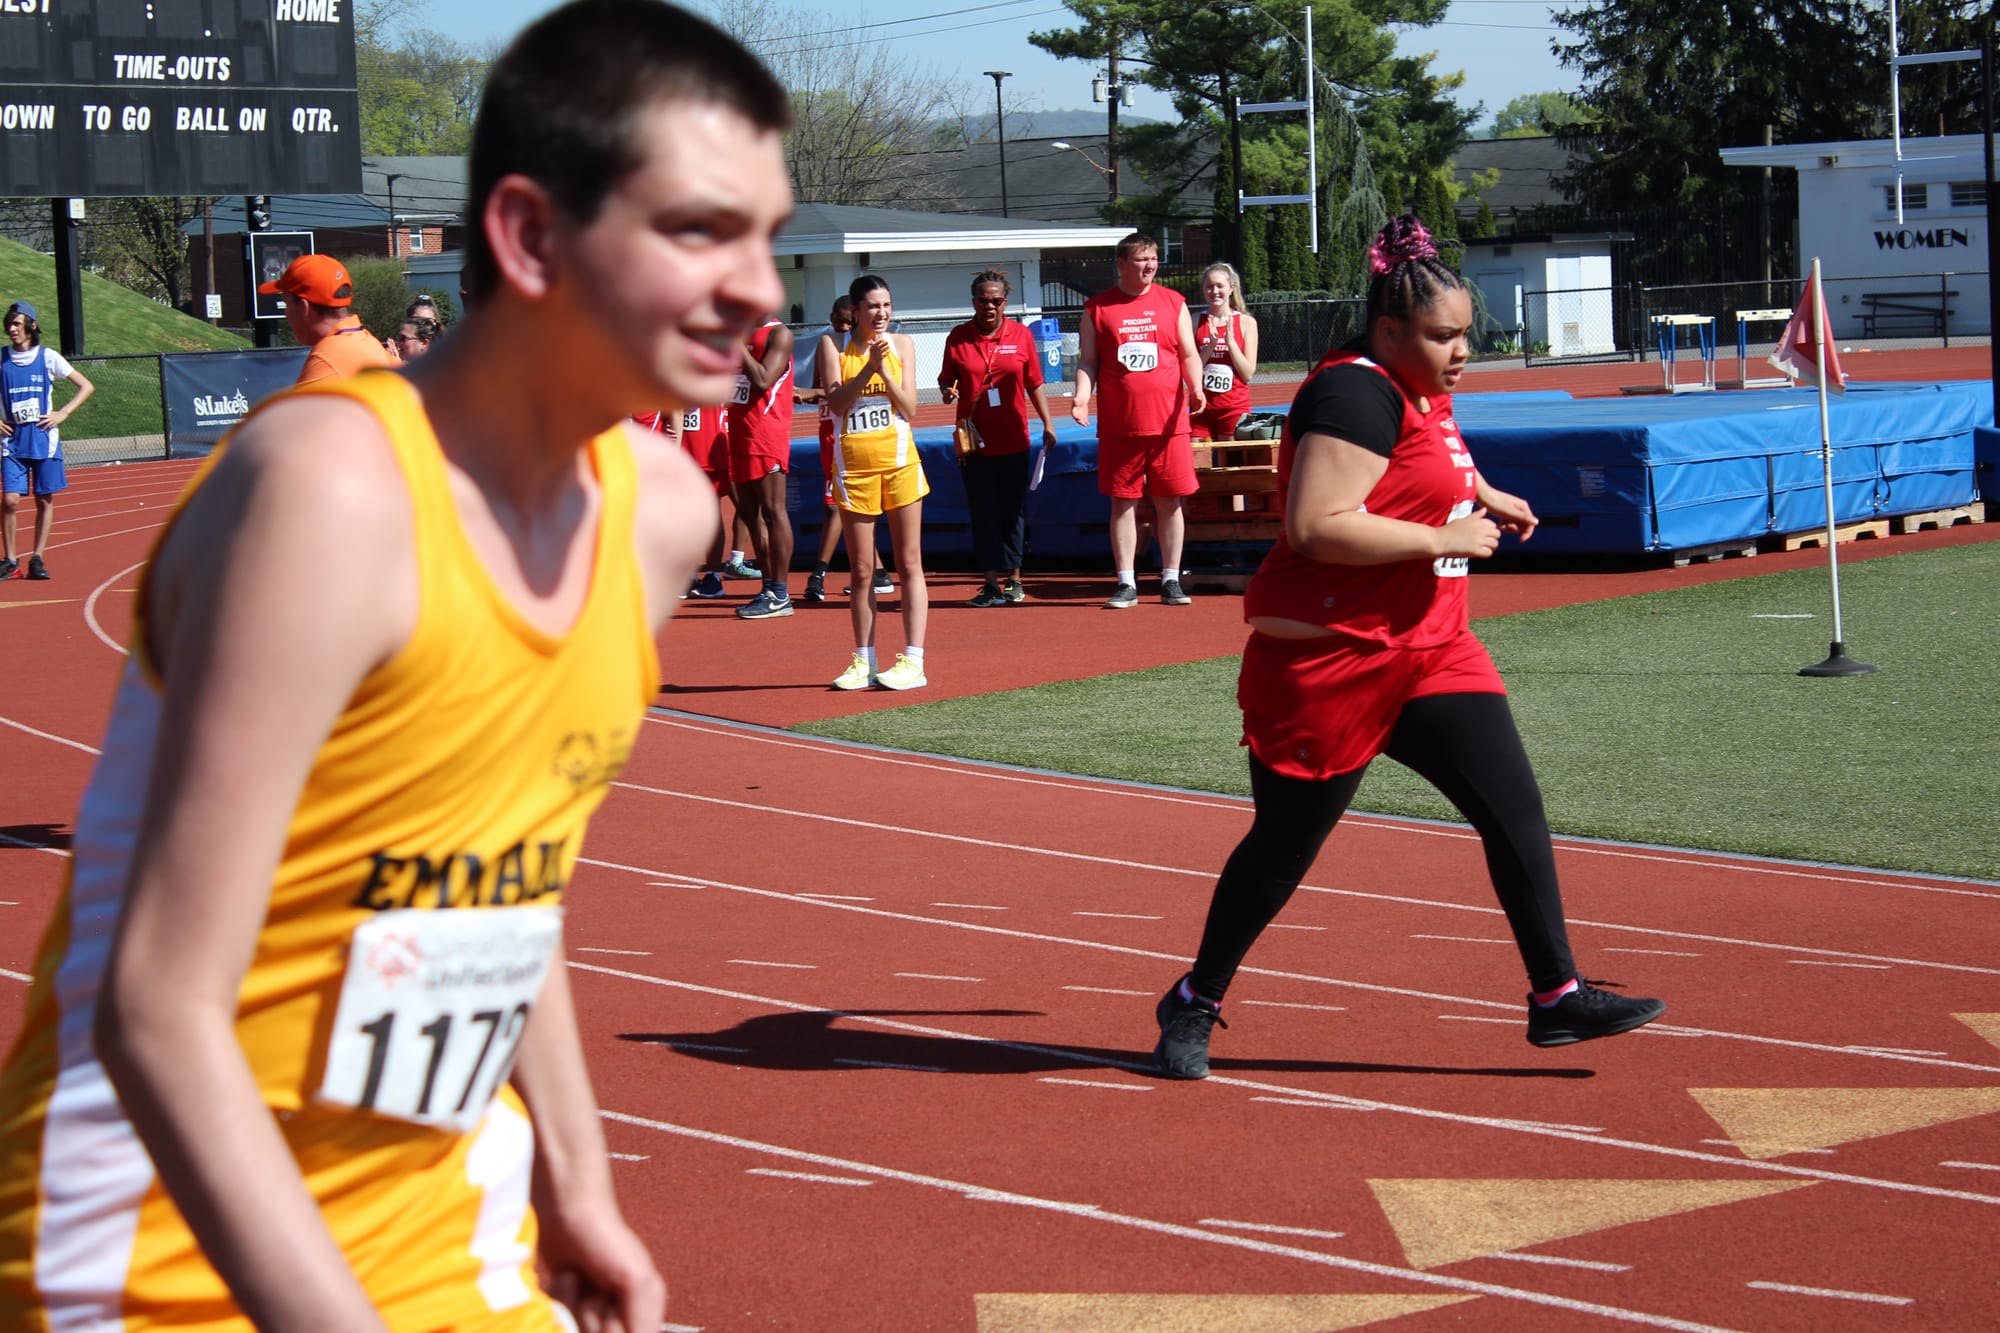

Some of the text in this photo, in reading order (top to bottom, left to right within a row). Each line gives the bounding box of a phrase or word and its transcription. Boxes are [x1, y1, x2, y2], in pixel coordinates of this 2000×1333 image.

[276, 0, 341, 23] HOME
[113, 54, 231, 81] TIME-OUTS
[83, 105, 151, 131] TO GO
[176, 106, 267, 131] BALL ON
[291, 107, 339, 133] QTR.
[1873, 227, 1968, 250] WOMEN
[1121, 354, 1156, 368] 1270
[848, 409, 890, 430] 1169
